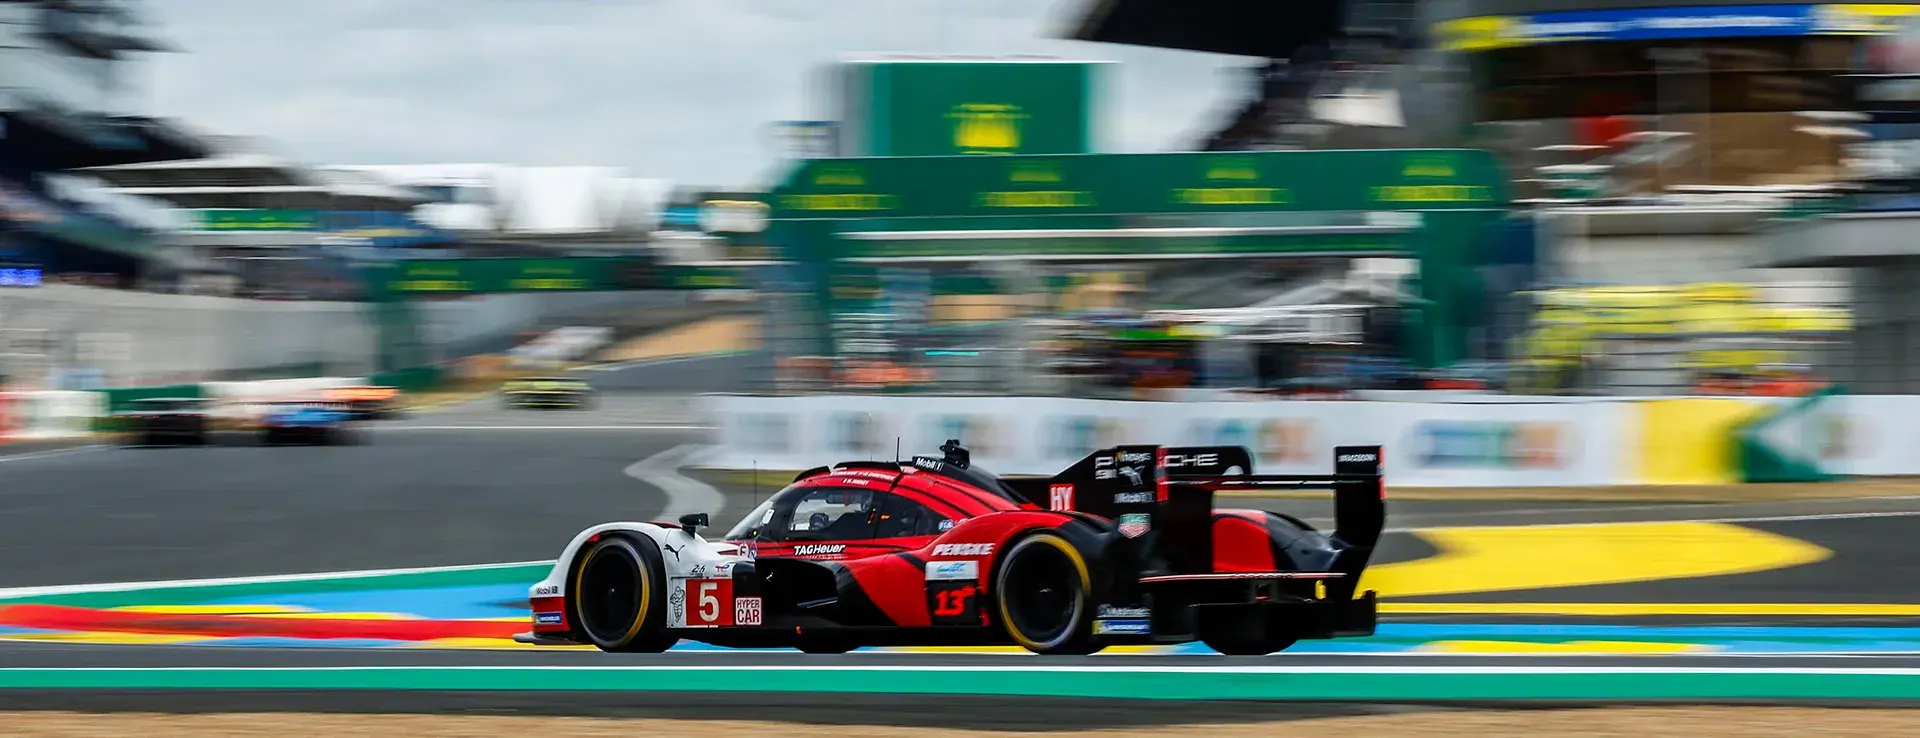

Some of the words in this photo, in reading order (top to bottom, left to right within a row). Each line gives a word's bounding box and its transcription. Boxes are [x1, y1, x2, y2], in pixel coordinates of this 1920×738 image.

[915, 457, 936, 469] Mobil
[1050, 486, 1073, 511] HY
[931, 543, 996, 556] PENSKE
[699, 582, 720, 622] 5
[737, 600, 760, 608] HYPER
[737, 609, 760, 623] CAR
